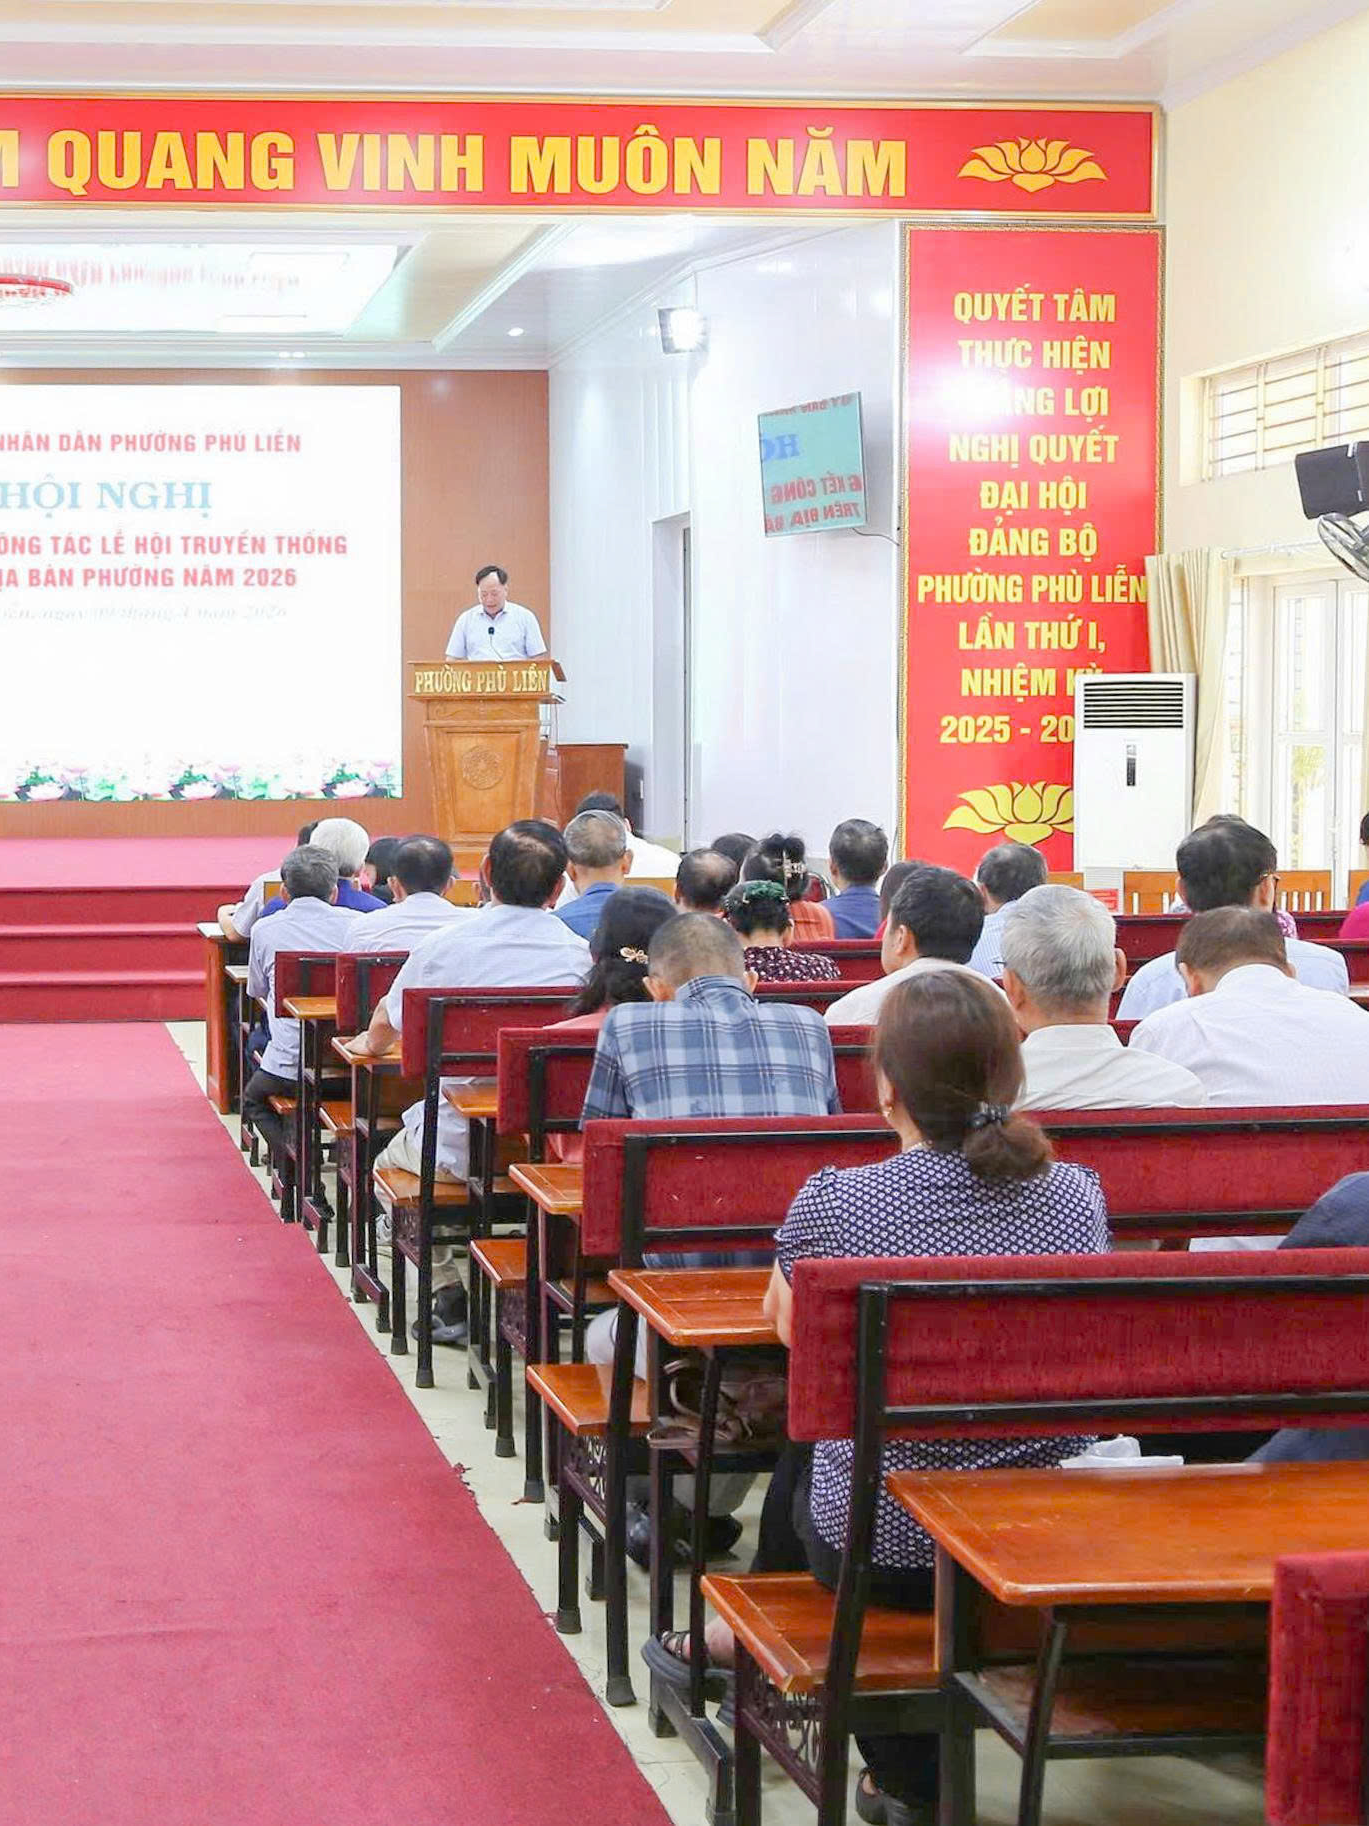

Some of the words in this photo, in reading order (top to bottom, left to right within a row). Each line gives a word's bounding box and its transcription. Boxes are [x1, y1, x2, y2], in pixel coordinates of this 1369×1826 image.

[47, 129, 295, 196] QUANG
[317, 133, 484, 192] VINH
[510, 124, 721, 195] MUÔN
[747, 127, 906, 197] NĂM
[953, 283, 1044, 324] QUYẾT
[1054, 288, 1116, 323] TÂM
[958, 337, 1032, 375] THỰC
[1042, 335, 1111, 375] HIỆN
[1064, 386, 1108, 423] LỢI
[59, 430, 102, 452] DÂN
[949, 432, 1019, 468] NGHỊ
[1029, 424, 1119, 465] QUYẾT
[96, 481, 213, 518] NGHỊ
[980, 481, 1028, 515] ĐẠI
[1038, 475, 1086, 515] HỘI
[50, 532, 92, 555] TÁC
[135, 532, 172, 559] HỘI
[969, 516, 1049, 556] ĐẢNG
[1059, 522, 1097, 562] BỘ
[183, 564, 234, 587] NĂM
[243, 568, 297, 588] 2026
[918, 567, 1023, 603] PHƯỜNG
[1032, 569, 1083, 603] PHÙ
[958, 611, 1015, 650] LẦN
[1025, 613, 1083, 650] THỨ
[1088, 622, 1106, 653] I,
[415, 664, 472, 693] PHƯỜNG
[476, 665, 507, 693] PHÙ
[961, 662, 1056, 702] NHIỆM
[940, 715, 1010, 743] 2025
[1040, 715, 1074, 743] 20
